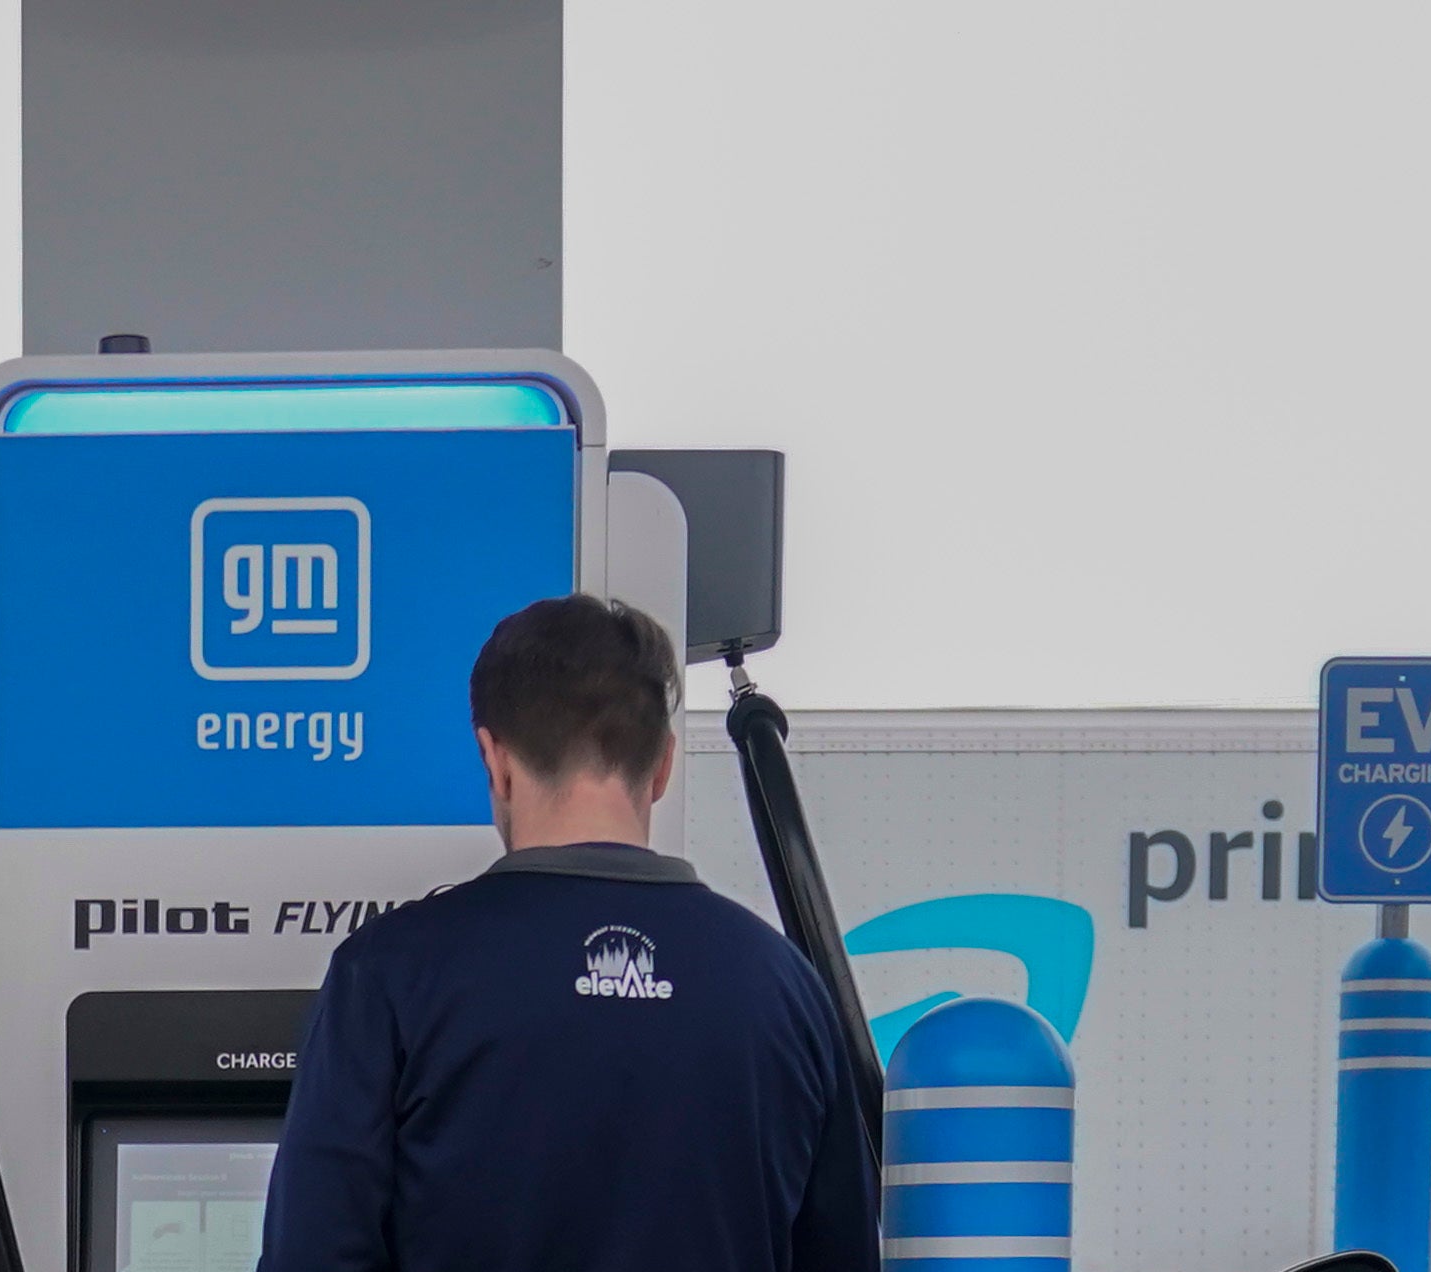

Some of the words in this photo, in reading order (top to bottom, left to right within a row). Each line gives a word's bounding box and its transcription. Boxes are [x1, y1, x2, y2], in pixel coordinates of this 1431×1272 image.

[223, 544, 338, 634] gm
[197, 712, 363, 761] energy
[217, 1052, 297, 1069] CHARGE
